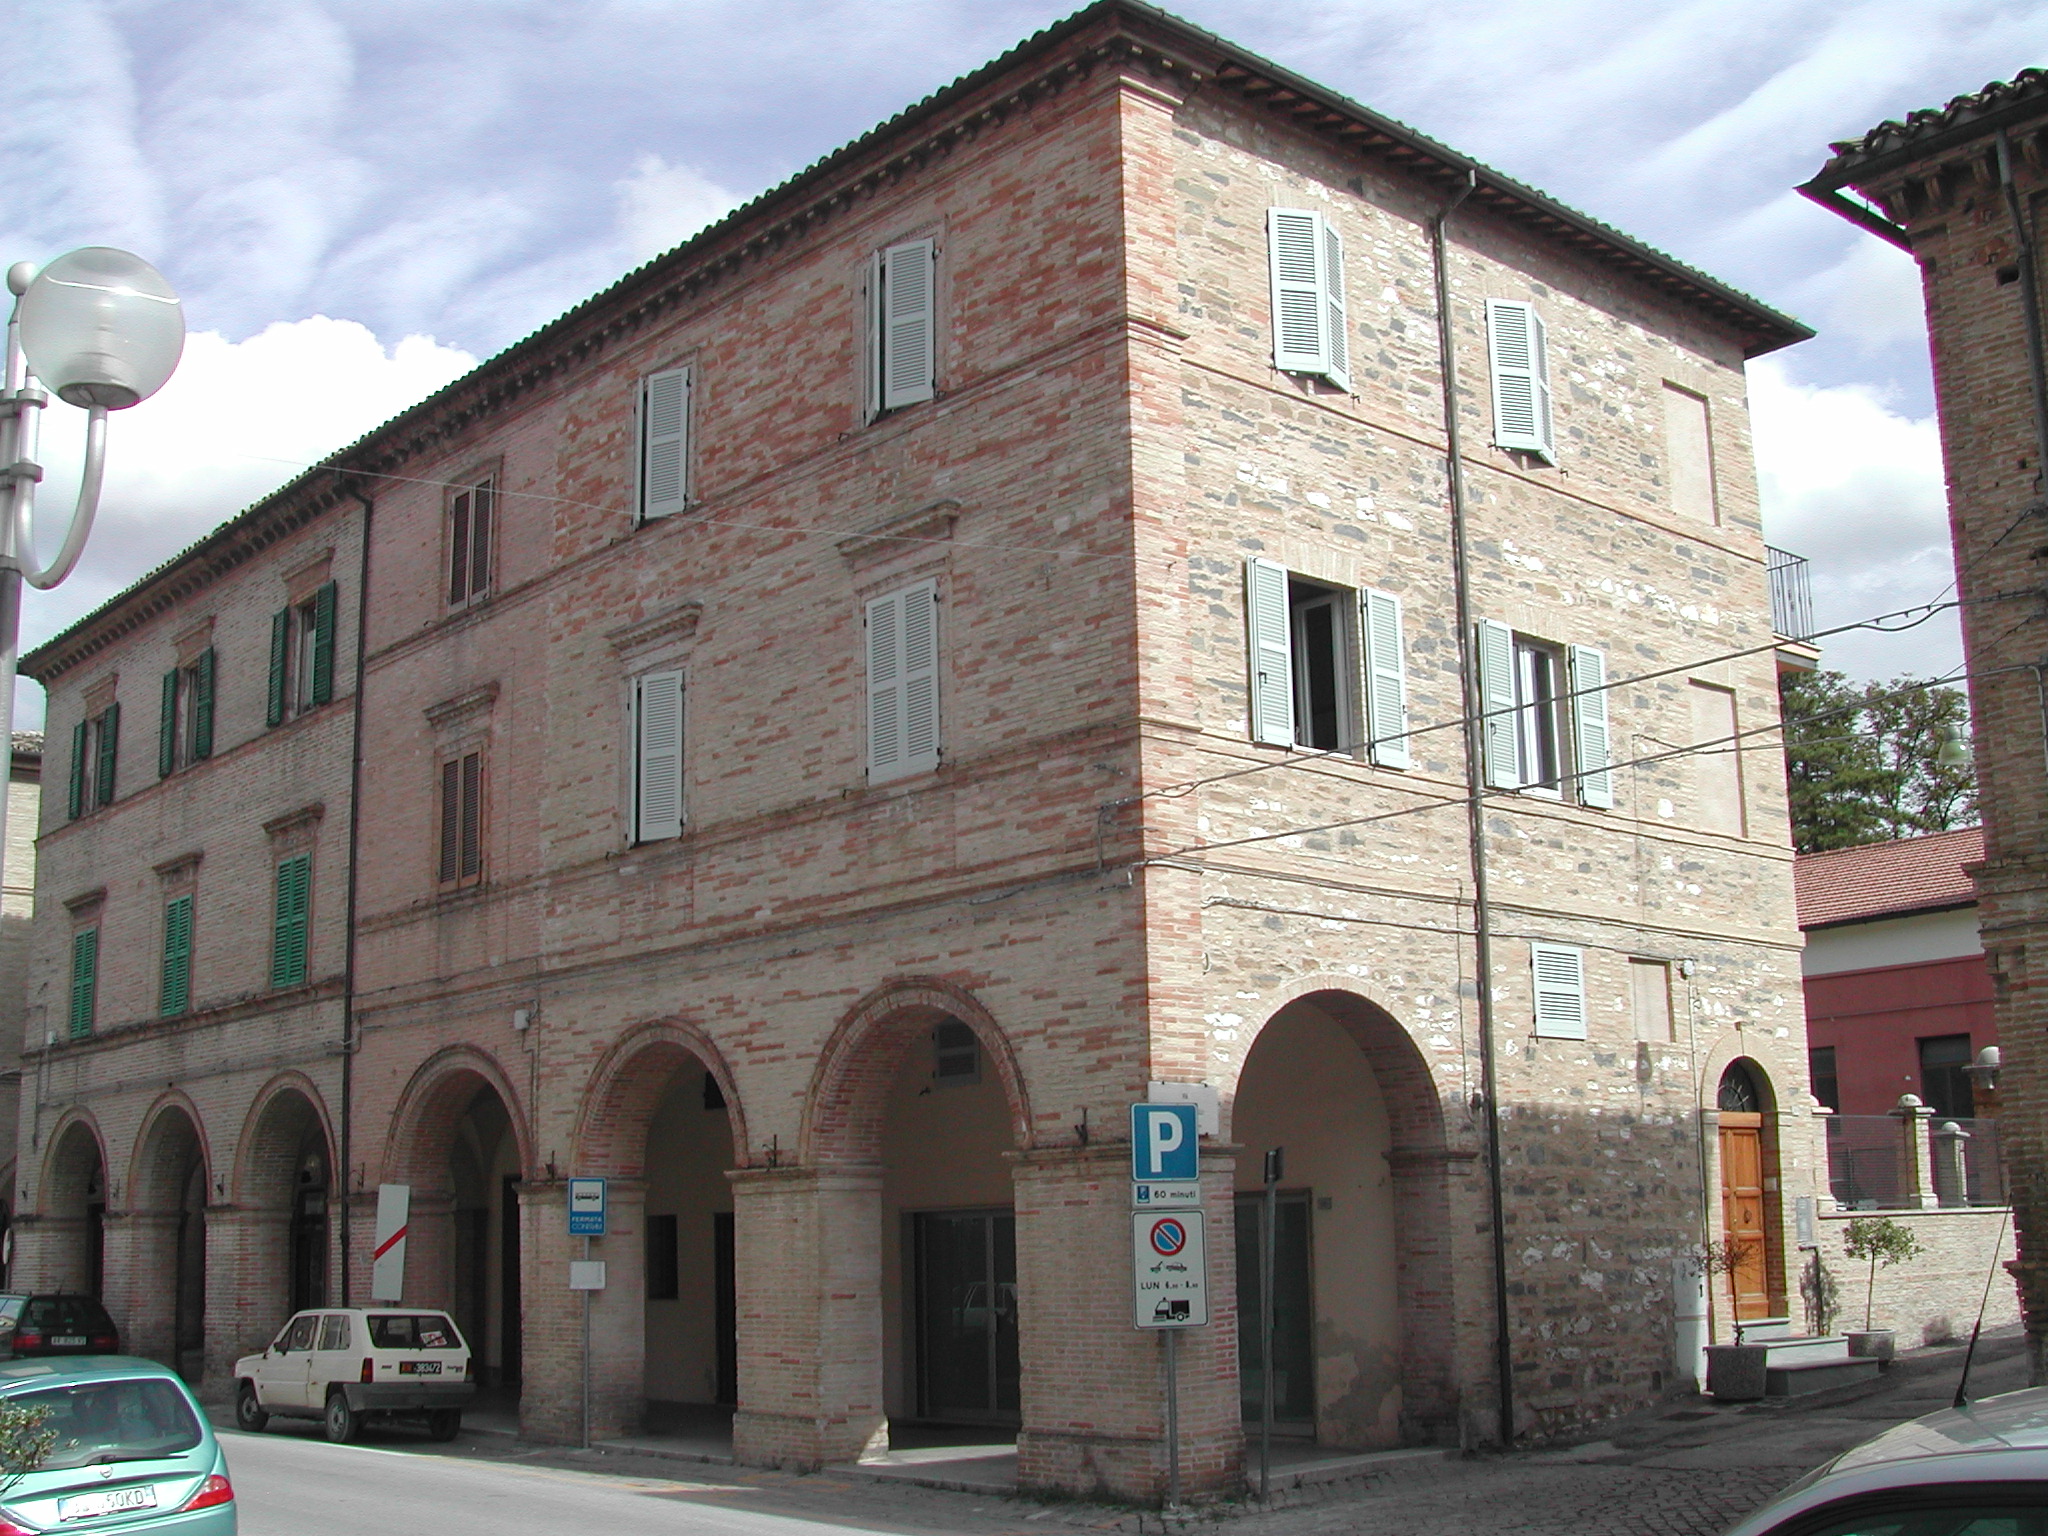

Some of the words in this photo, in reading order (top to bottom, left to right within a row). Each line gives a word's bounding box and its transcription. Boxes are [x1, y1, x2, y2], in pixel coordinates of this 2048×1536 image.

[1148, 1111, 1183, 1173] P
[1154, 1190, 1166, 1199] 60
[1170, 1190, 1196, 1199] minuti
[1141, 1282, 1160, 1290] LUN
